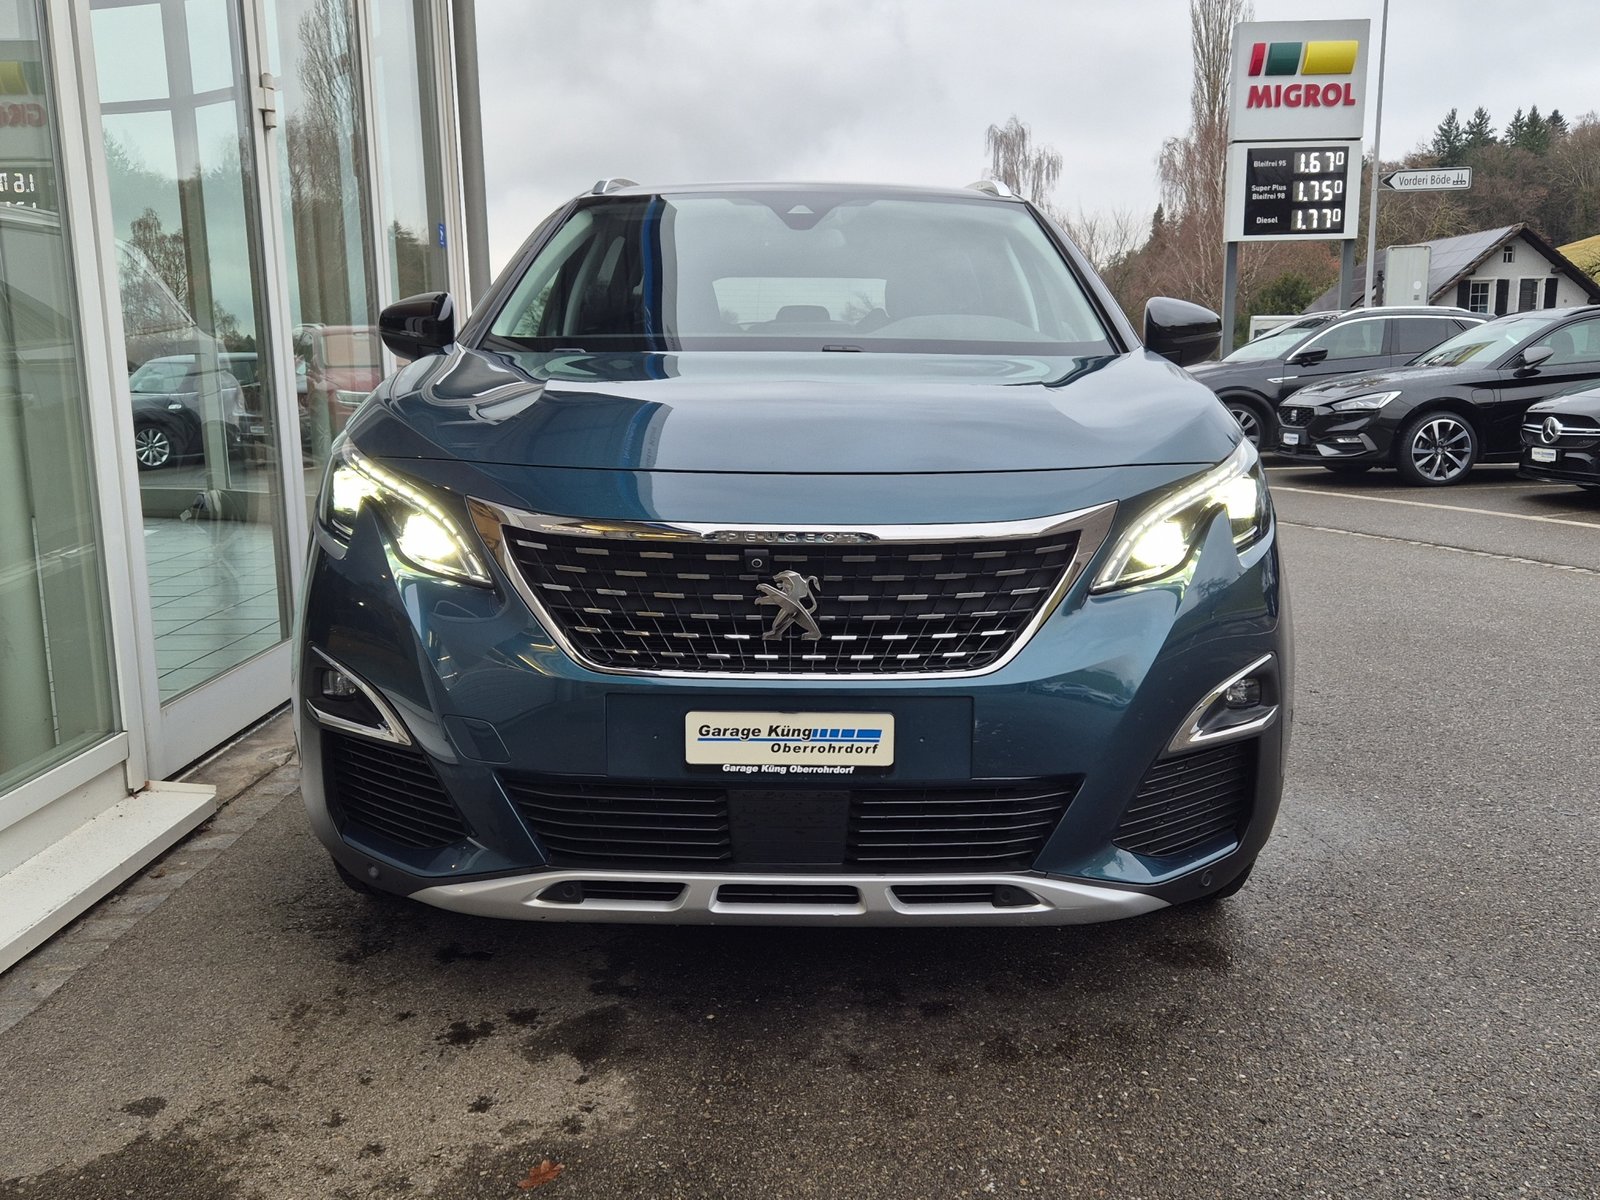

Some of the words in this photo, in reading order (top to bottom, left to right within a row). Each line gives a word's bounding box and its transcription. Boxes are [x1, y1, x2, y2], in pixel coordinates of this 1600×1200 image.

[1247, 82, 1356, 109] MIGROL
[1253, 160, 1277, 168] Bleifrei
[1399, 175, 1429, 186] Vorderi
[1430, 174, 1452, 185] Böde
[1251, 185, 1271, 193] Super
[1256, 216, 1279, 224] Diesel
[724, 532, 858, 543] PEUGEOT
[698, 725, 762, 740] Garage
[767, 725, 813, 740] Küng
[771, 743, 879, 755] Oberrohrdorf
[722, 763, 759, 773] Garage
[761, 763, 787, 774] Küng
[789, 765, 855, 775] Oberrohrdorf
